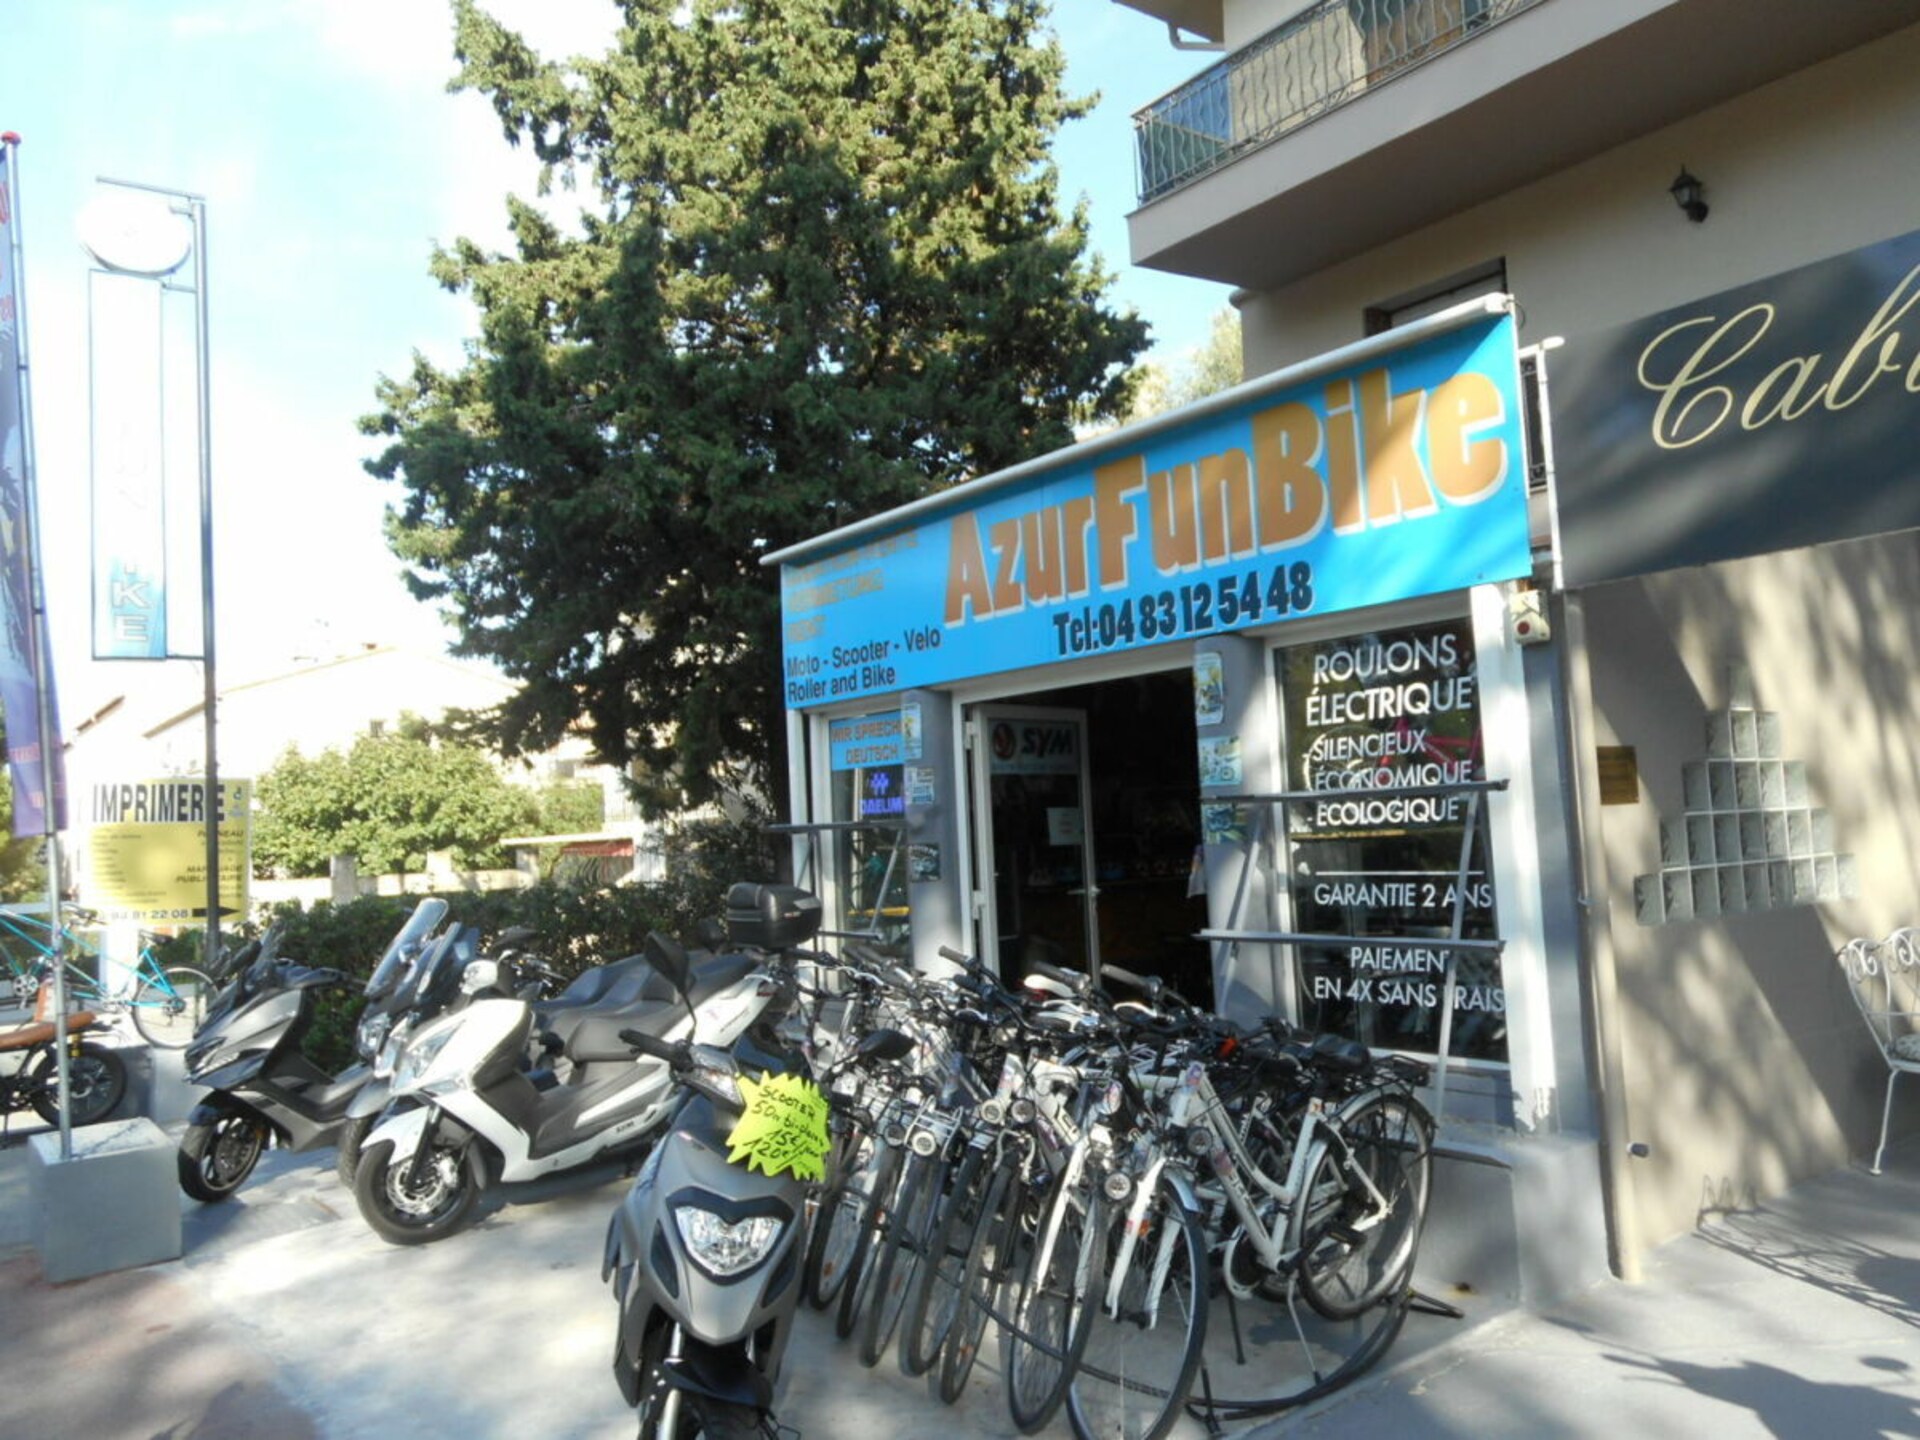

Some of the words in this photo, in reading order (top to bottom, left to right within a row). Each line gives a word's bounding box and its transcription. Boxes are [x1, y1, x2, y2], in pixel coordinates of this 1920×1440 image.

[1637, 262, 1920, 449] Cab
[943, 367, 1510, 629] AzurFunBike
[1139, 590, 1177, 641] 83
[1179, 582, 1214, 634] 12
[1217, 570, 1263, 626] 54
[1266, 561, 1313, 616] 48
[786, 655, 821, 678] Moto
[832, 638, 891, 669] Scooter
[903, 625, 942, 653] Velo
[1312, 633, 1458, 686] ROULONS
[787, 678, 828, 703] Roller
[830, 672, 858, 696] and
[861, 665, 896, 690] Bike
[1306, 676, 1473, 728] ÉLECTRIQUE
[1021, 725, 1073, 758] SYM
[1311, 728, 1428, 763] SILENCIEUX
[1313, 759, 1473, 792] ÉCONOMIQUE
[92, 783, 225, 823] IMPRIMERE
[151, 909, 170, 919] 22
[1314, 883, 1417, 908] GARANTIE
[1421, 883, 1437, 908] 2
[1441, 882, 1494, 908] ANS
[1314, 976, 1342, 1001] EN
[1346, 979, 1374, 1004] 4X
[1377, 983, 1438, 1008] SANS
[1444, 985, 1506, 1012] RAIS
